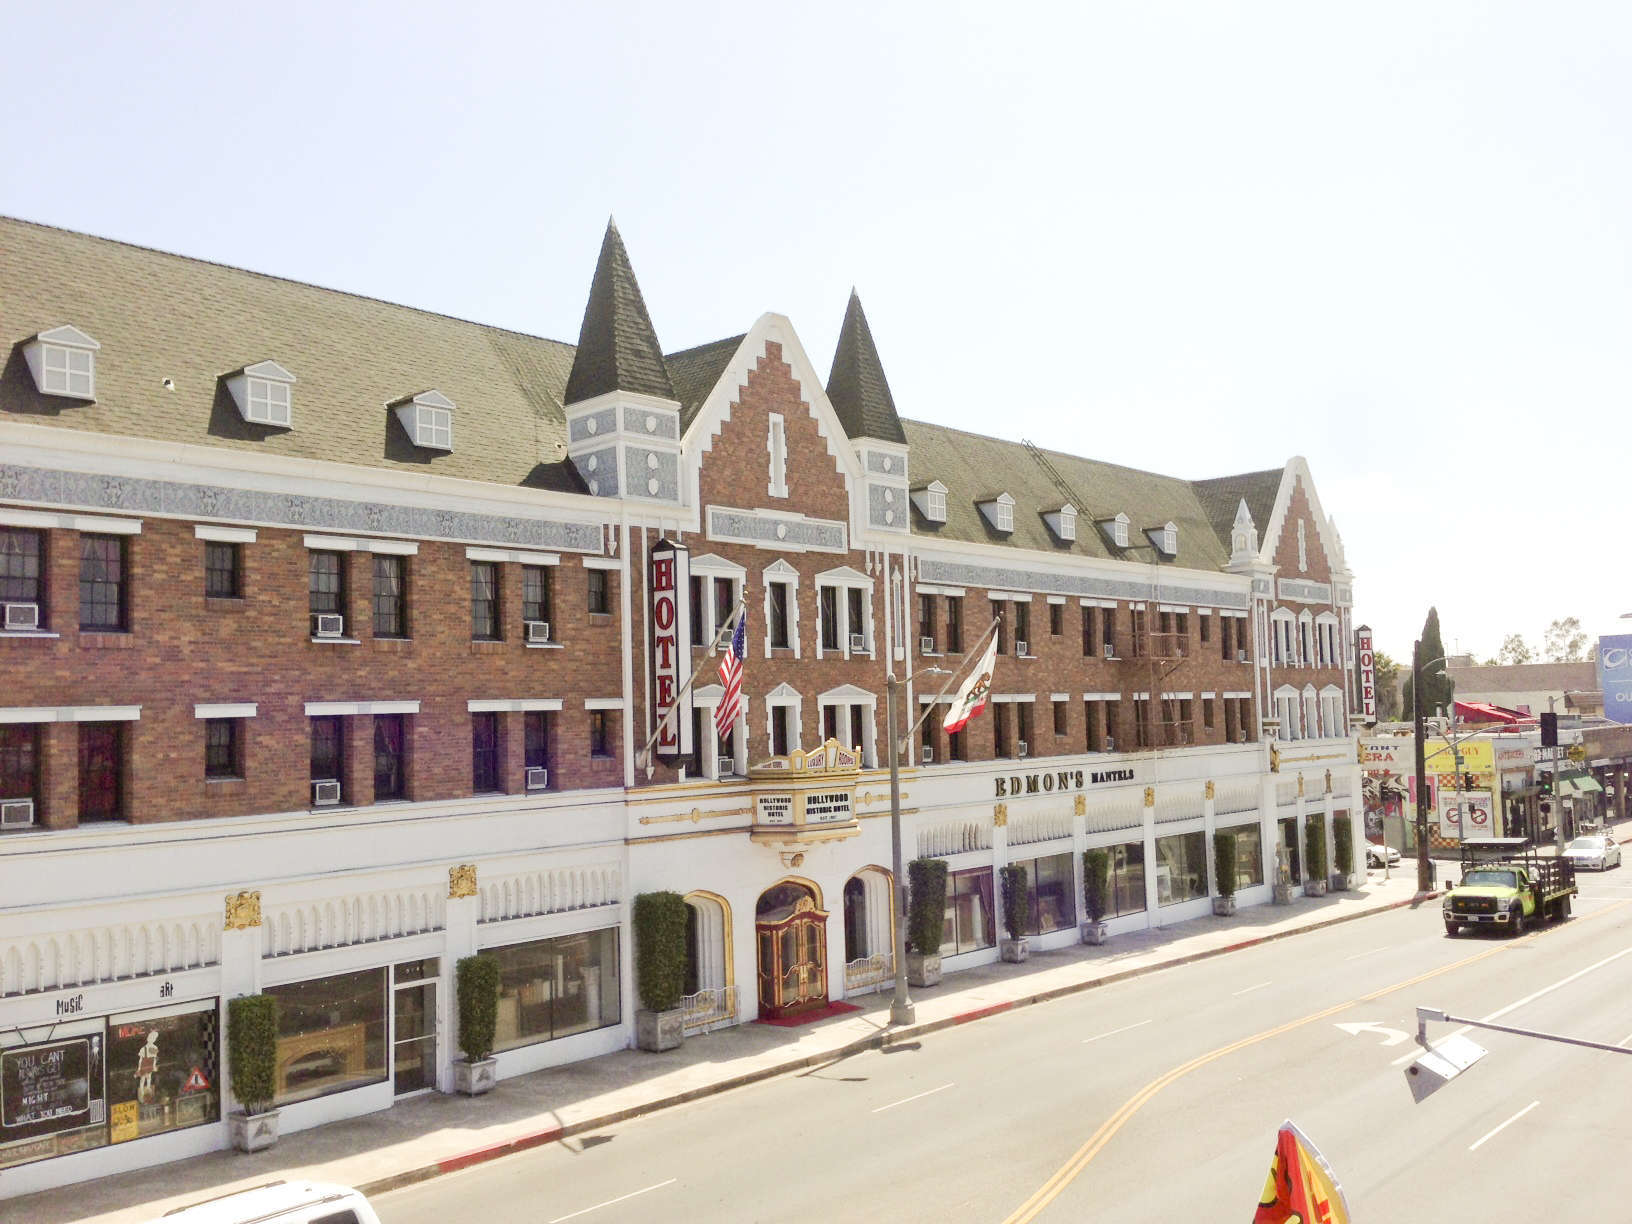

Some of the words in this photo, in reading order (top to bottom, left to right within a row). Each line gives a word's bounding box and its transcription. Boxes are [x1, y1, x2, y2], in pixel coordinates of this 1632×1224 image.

[652, 558, 676, 747] HOTEL
[1359, 637, 1374, 715] HOTEL
[994, 770, 1083, 797] EDMON'S
[1091, 769, 1134, 783] MANTELS
[806, 806, 832, 815] HISTORIC
[833, 804, 850, 813] HOTEL
[807, 793, 848, 805] HOLLYWOOD
